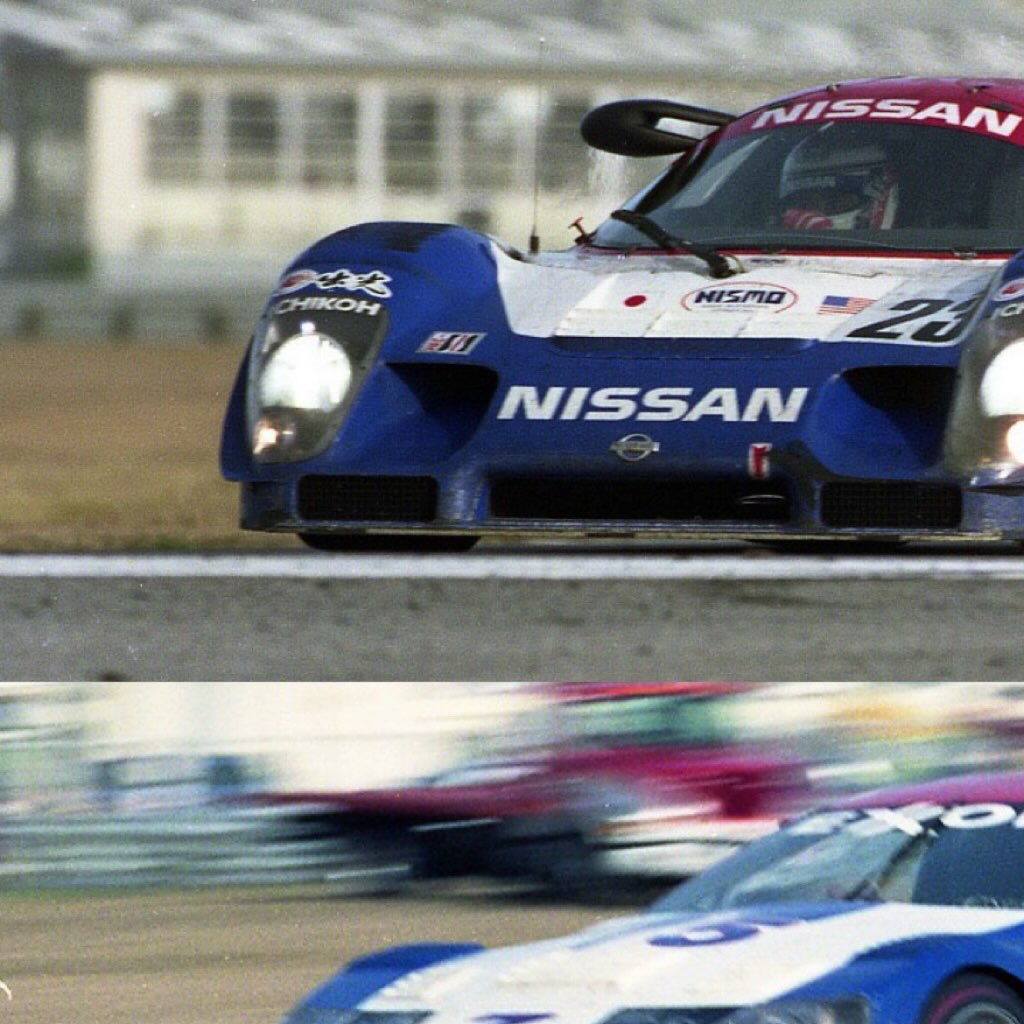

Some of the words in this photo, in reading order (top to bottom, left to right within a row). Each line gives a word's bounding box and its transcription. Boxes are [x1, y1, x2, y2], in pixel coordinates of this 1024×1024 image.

[751, 98, 1023, 137] NISSAN
[693, 287, 787, 306] NISMO
[847, 297, 976, 342] 23
[496, 386, 809, 422] NISSAN
